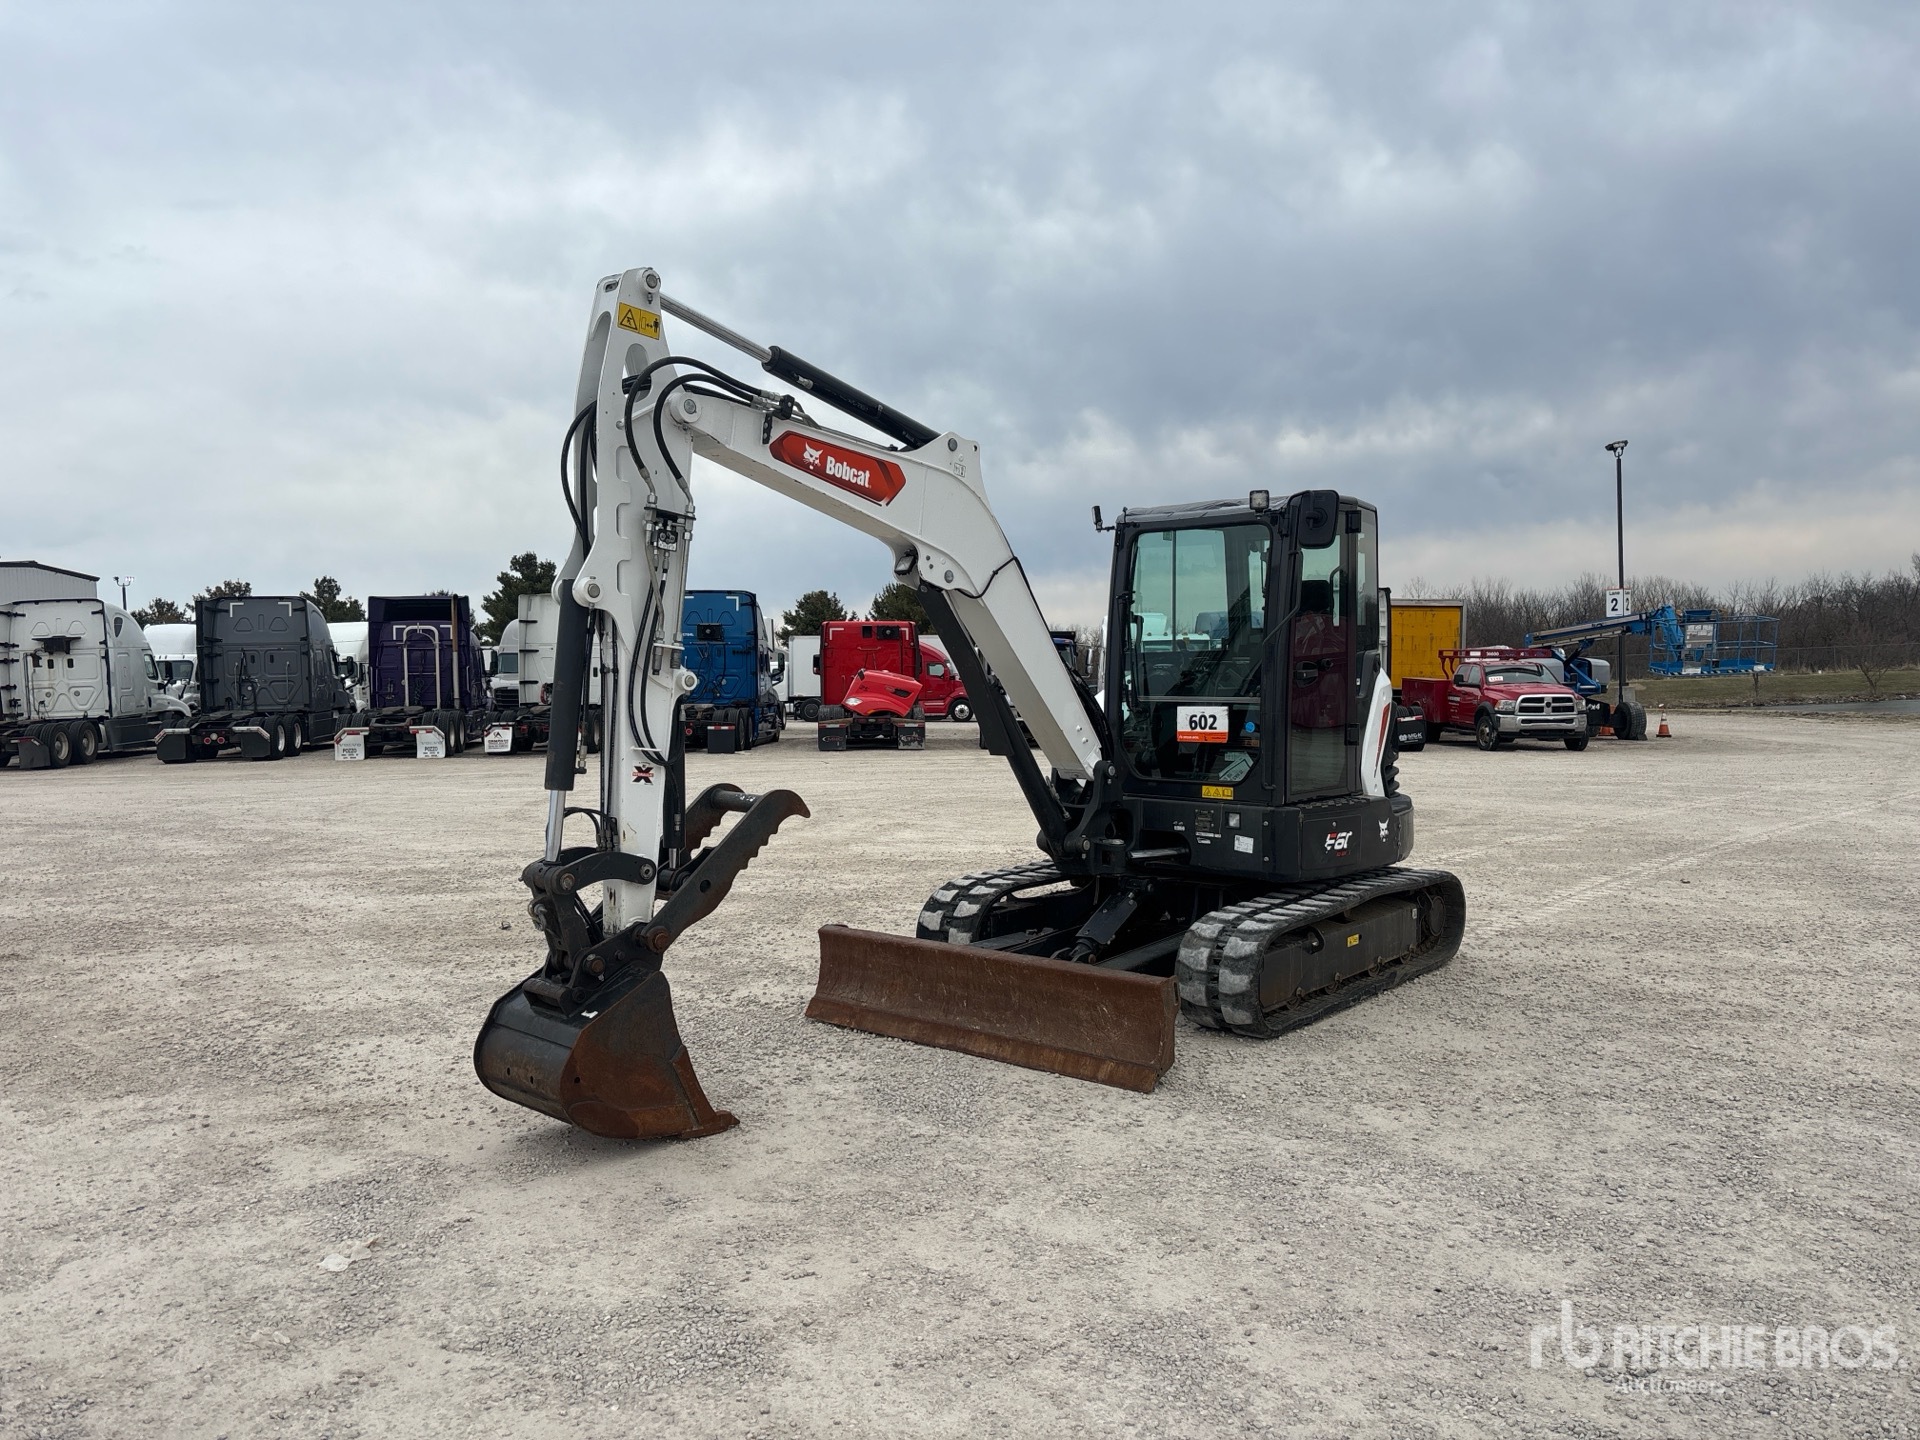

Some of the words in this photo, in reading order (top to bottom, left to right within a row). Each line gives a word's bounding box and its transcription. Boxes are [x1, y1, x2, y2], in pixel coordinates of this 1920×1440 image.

[826, 455, 870, 488] Bobcat
[1611, 598, 1618, 611] 2
[1626, 598, 1630, 611] 2
[1189, 714, 1217, 730] 602
